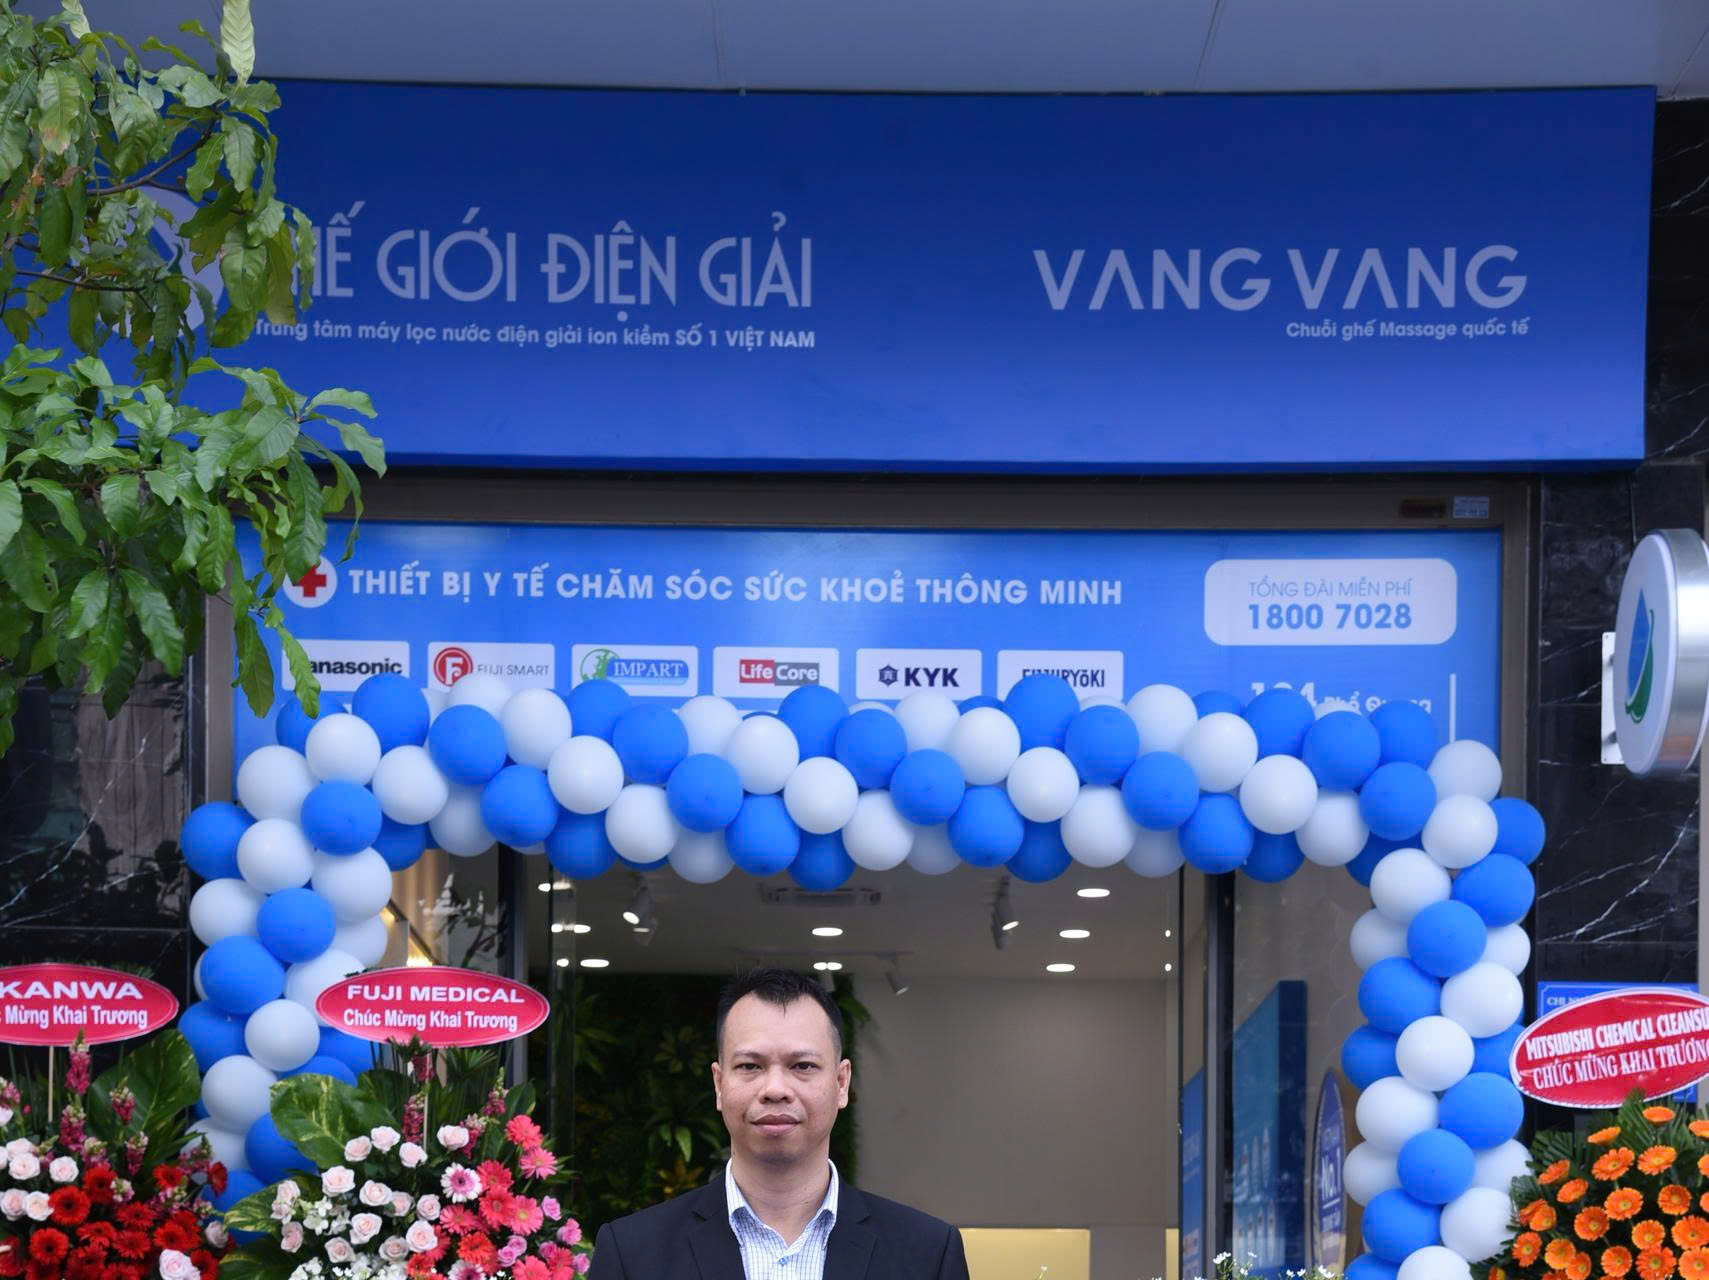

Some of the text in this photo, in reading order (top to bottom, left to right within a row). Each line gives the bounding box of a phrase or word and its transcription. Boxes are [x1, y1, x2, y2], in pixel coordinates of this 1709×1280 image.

[376, 207, 517, 303] GIỚI
[540, 220, 676, 321] ĐIỆN
[699, 211, 812, 307] GIẢI
[1033, 245, 1527, 311] VANG VANG
[313, 320, 352, 337] tâm
[358, 321, 400, 342] máy
[406, 323, 437, 344] lọc
[443, 325, 490, 342] nước
[497, 325, 539, 347] điện
[545, 324, 582, 348] giải
[588, 328, 617, 344] ion
[675, 323, 703, 346] SỐ
[709, 330, 717, 346] 1
[725, 326, 764, 351] VIỆT
[770, 331, 815, 348] NAM
[1341, 318, 1378, 341] ghế
[1380, 322, 1457, 340] Massage
[1462, 317, 1506, 339] quốc
[1511, 316, 1531, 335] tế
[348, 560, 431, 596] THIẾT
[443, 571, 471, 603] BỊ
[483, 572, 502, 597] Y
[513, 563, 550, 598] TẾ
[556, 568, 653, 599] CHĂM
[665, 568, 733, 601] SÓC
[744, 568, 807, 601] SỨC
[916, 572, 1028, 604] THÔNG
[1040, 580, 1122, 605] MINH
[1304, 578, 1333, 597] ĐÀI
[1385, 577, 1412, 596] PHÍ
[1248, 603, 1412, 630] 1800 7028
[308, 658, 402, 675] anasonic
[507, 664, 549, 676] SMART
[614, 661, 683, 677] IMPART
[904, 667, 960, 687] KYK
[347, 985, 525, 1003] FUJI MEDICAL
[5, 1004, 49, 1029] Mừng
[53, 1005, 88, 1025] Khai
[91, 1005, 148, 1028] Trương
[343, 1007, 518, 1032] Chúc Mừng Khai Trương
[1525, 1028, 1594, 1061] MITSUBISHI
[1595, 1016, 1657, 1049] CHEMICAL
[1533, 1057, 1574, 1089] CHÚC
[1574, 1052, 1619, 1083] MỪNG
[1618, 1047, 1657, 1076] KHAI
